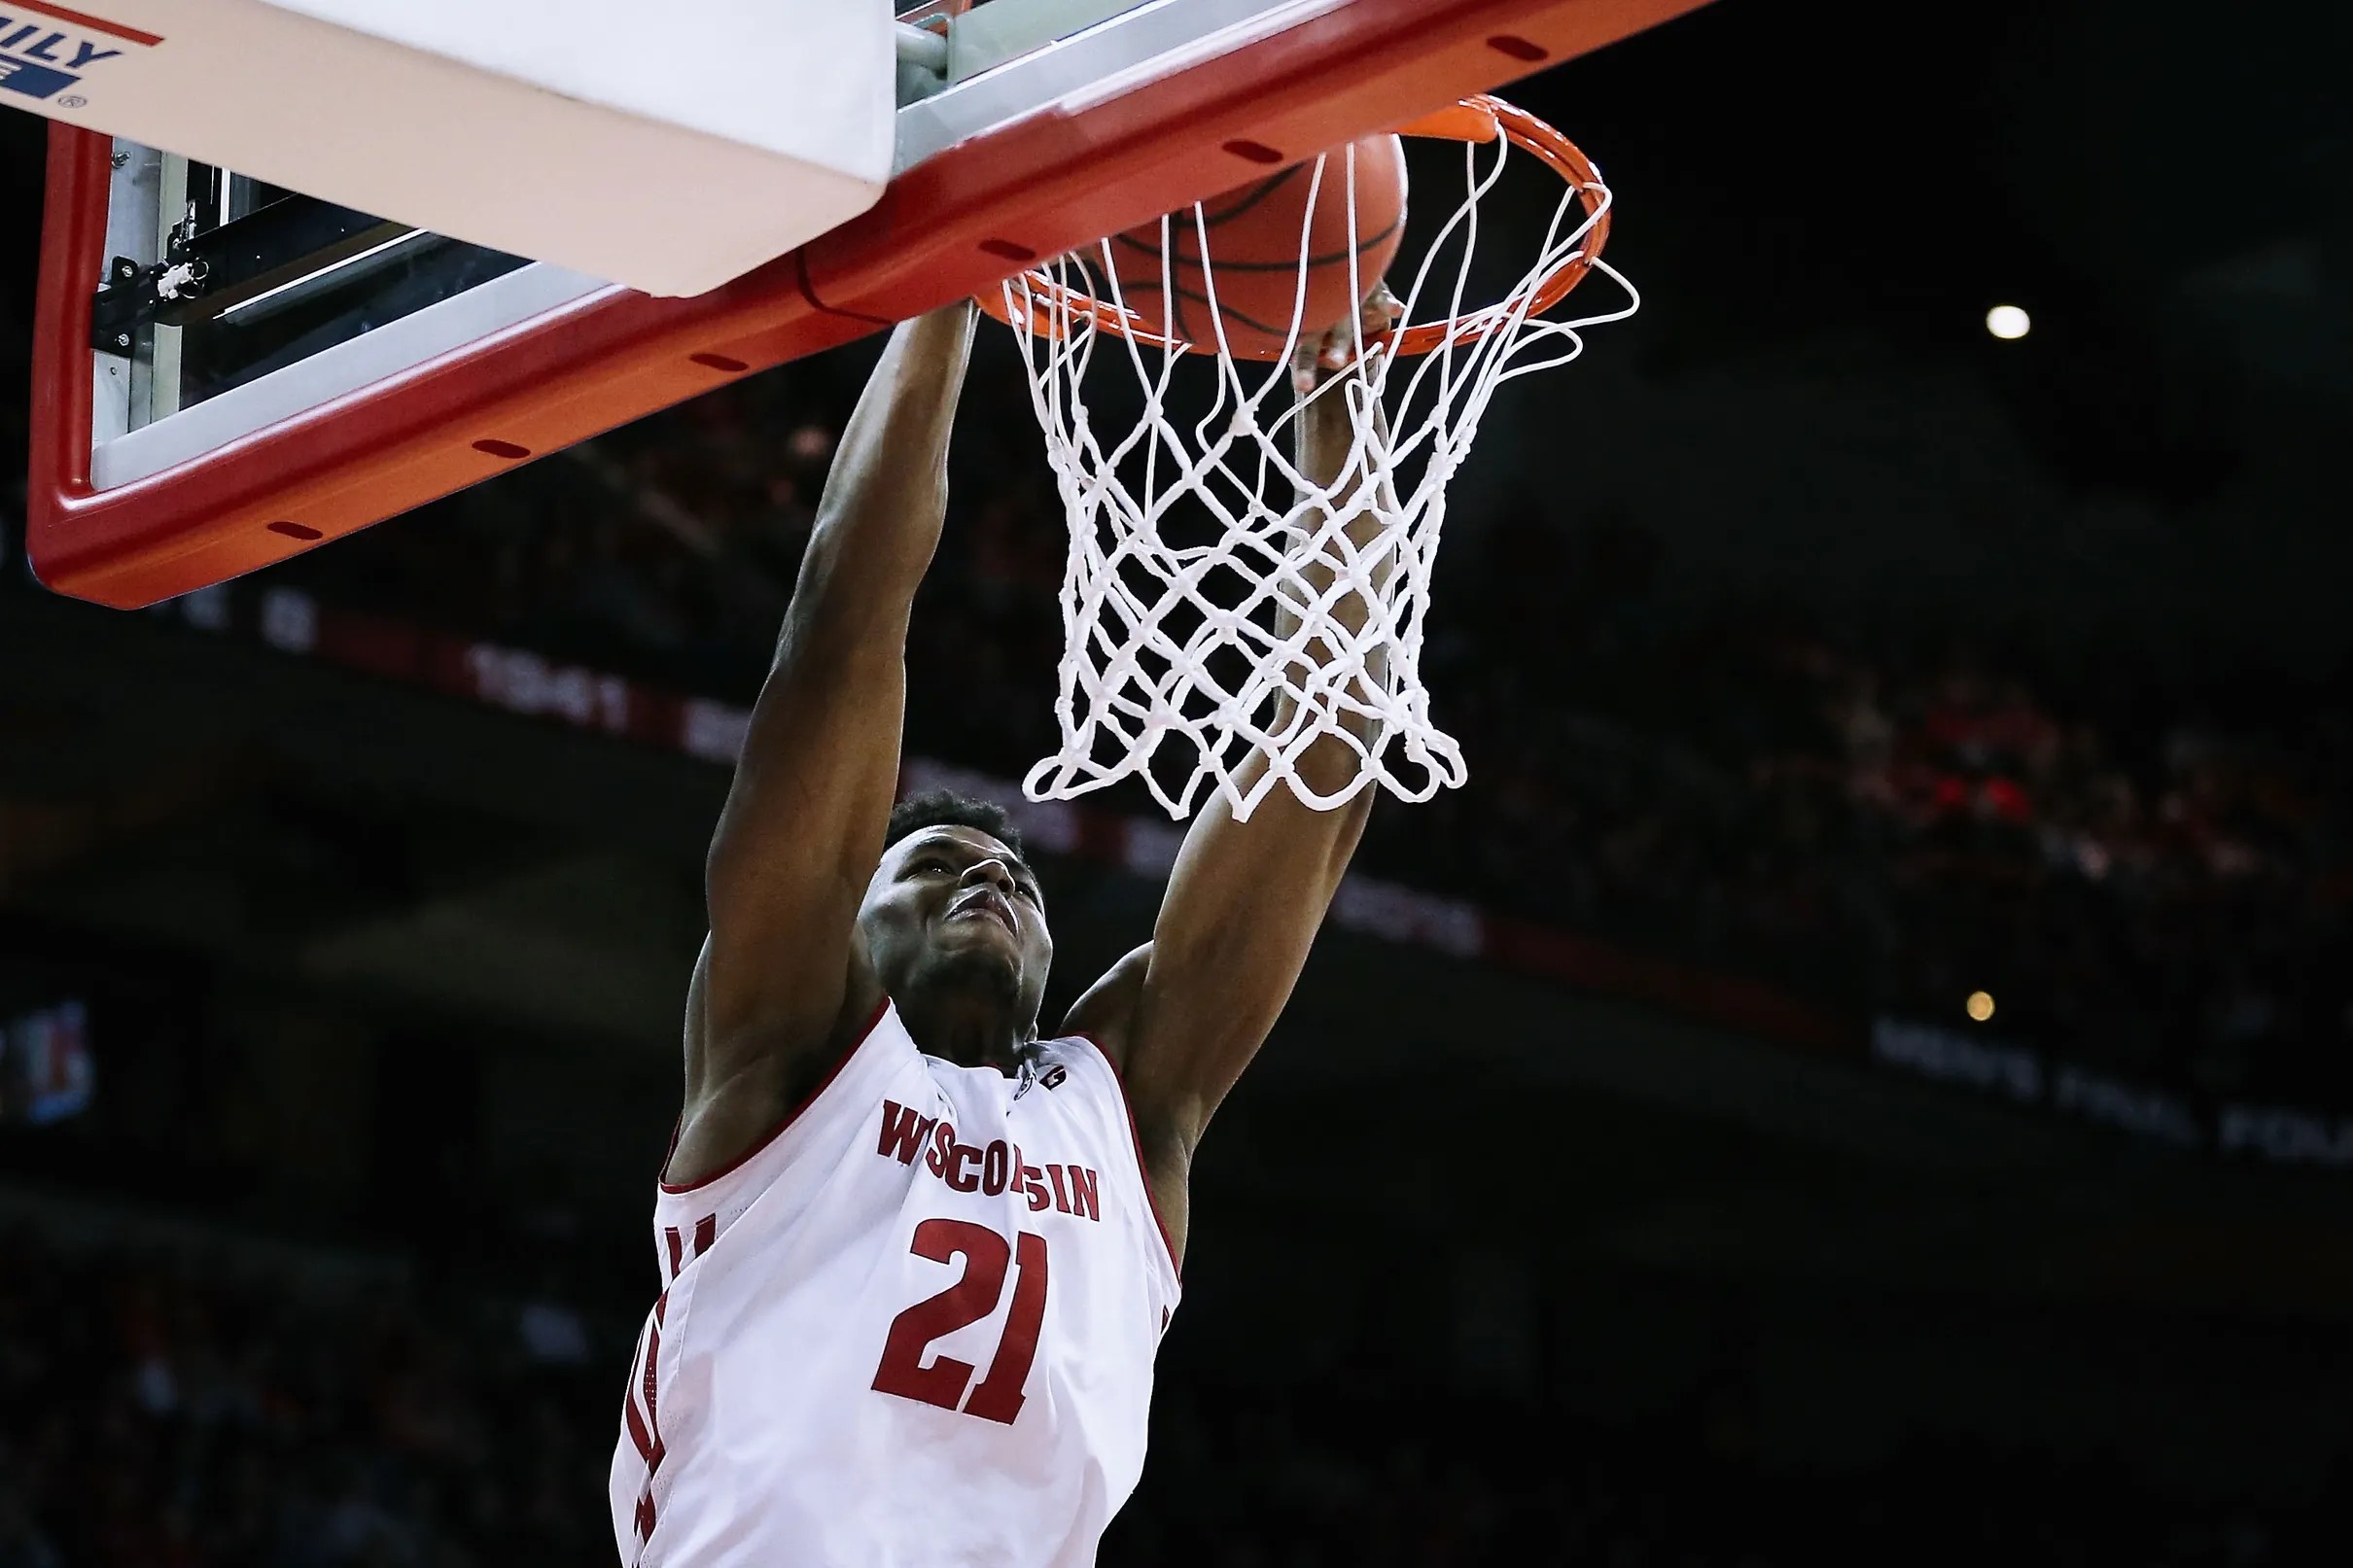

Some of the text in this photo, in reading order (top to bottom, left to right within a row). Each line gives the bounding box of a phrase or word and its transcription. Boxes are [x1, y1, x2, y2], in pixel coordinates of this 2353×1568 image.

[0, 17, 122, 68] ILY
[877, 1099, 1100, 1222] WSCOSIN
[871, 1219, 1048, 1426] 21
